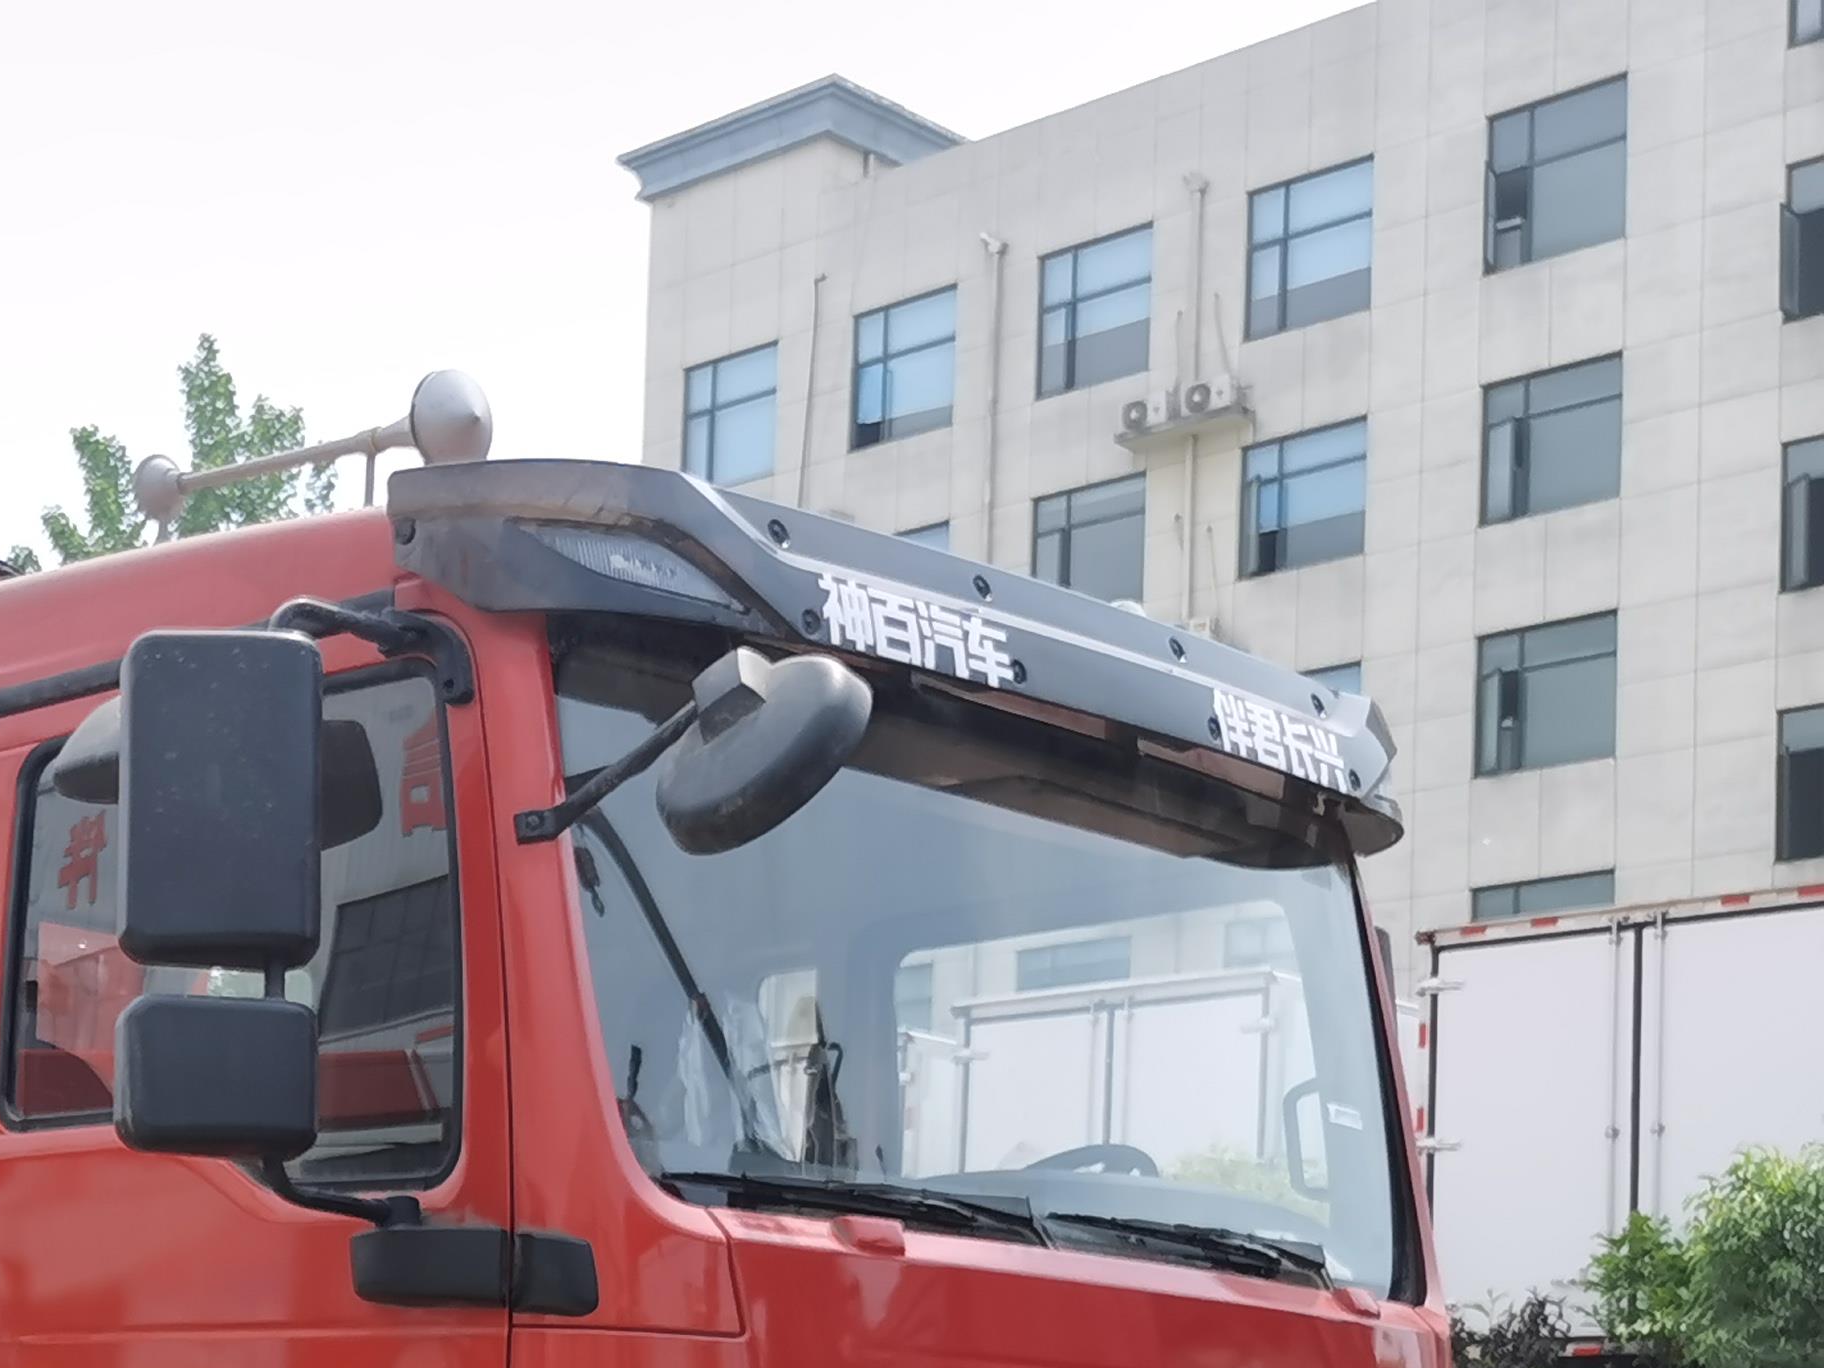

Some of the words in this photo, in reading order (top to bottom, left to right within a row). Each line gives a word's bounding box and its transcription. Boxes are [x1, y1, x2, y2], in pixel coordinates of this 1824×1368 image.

[818, 571, 1015, 689] 神百汽车
[1213, 687, 1348, 794] 伴君长兴
